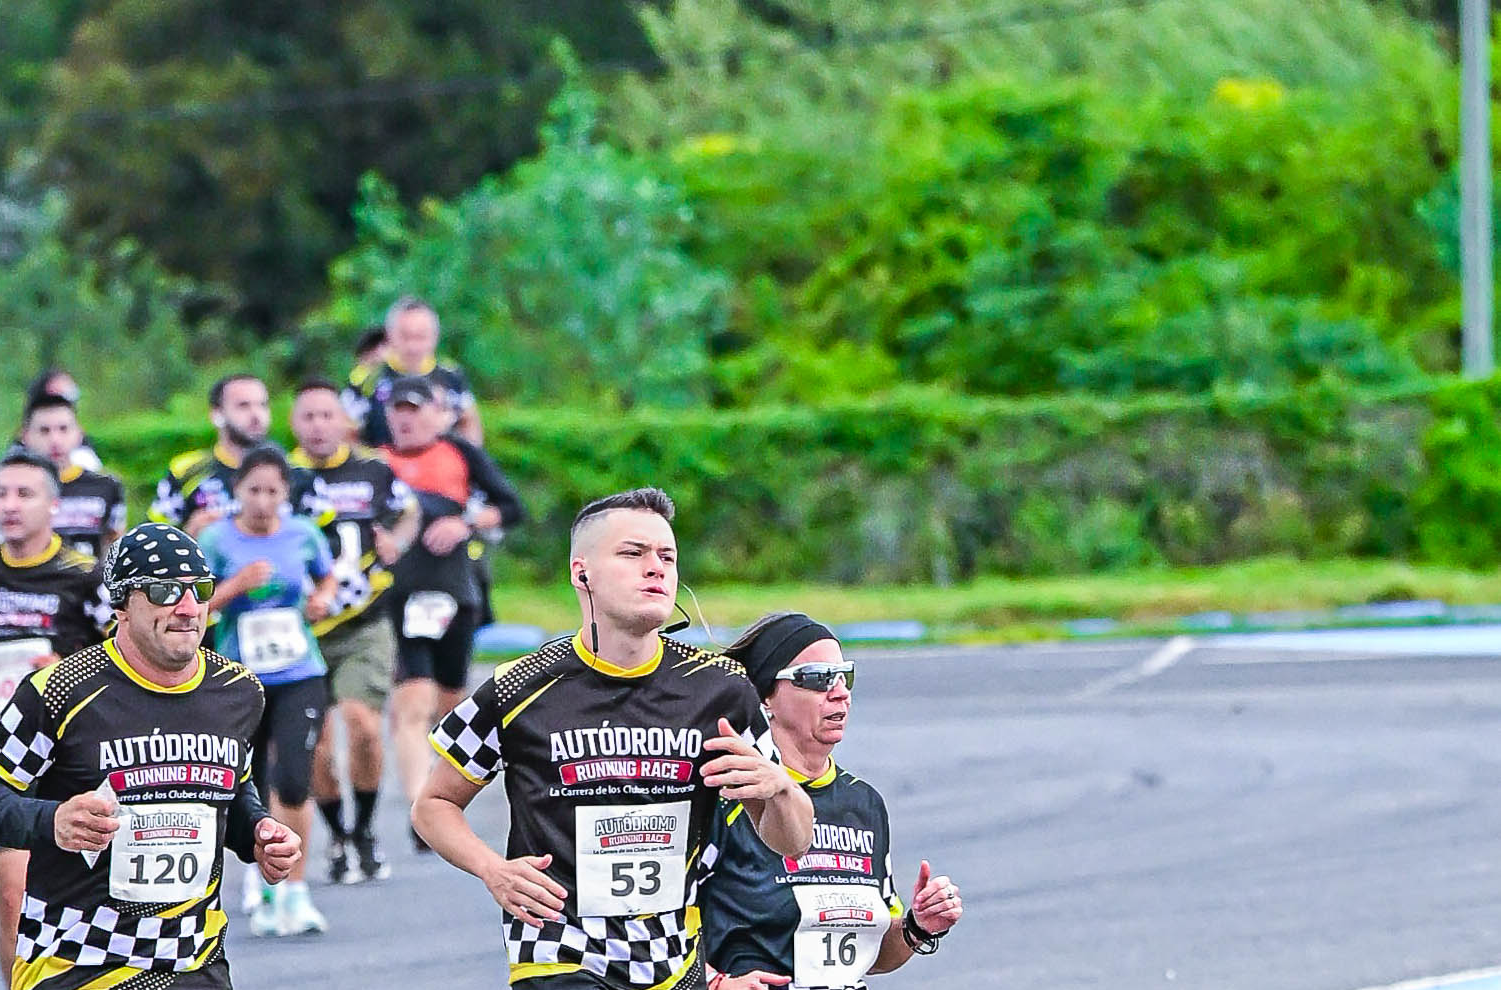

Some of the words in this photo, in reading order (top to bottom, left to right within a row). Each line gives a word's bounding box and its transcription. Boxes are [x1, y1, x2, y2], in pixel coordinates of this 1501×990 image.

[99, 728, 239, 770] AUTÓDROMO
[550, 720, 703, 762] AUTÓDROMO
[124, 766, 187, 788] RUNNING
[190, 766, 225, 786] RACE
[575, 761, 637, 782] RUNNING
[641, 762, 680, 779] RACE
[142, 792, 154, 800] de
[155, 791, 166, 799] los
[168, 790, 197, 799] Clubes
[199, 791, 212, 799] del
[549, 787, 560, 796] La
[561, 787, 594, 796] Carrera
[596, 786, 607, 795] de
[608, 785, 621, 794] los
[651, 785, 665, 794] del
[595, 813, 677, 836] AUTÓDROMO
[812, 817, 874, 855] ÓDROMO
[129, 853, 198, 884] 120
[839, 855, 865, 872] RACE
[611, 861, 661, 897] 53
[822, 932, 857, 966] 16
